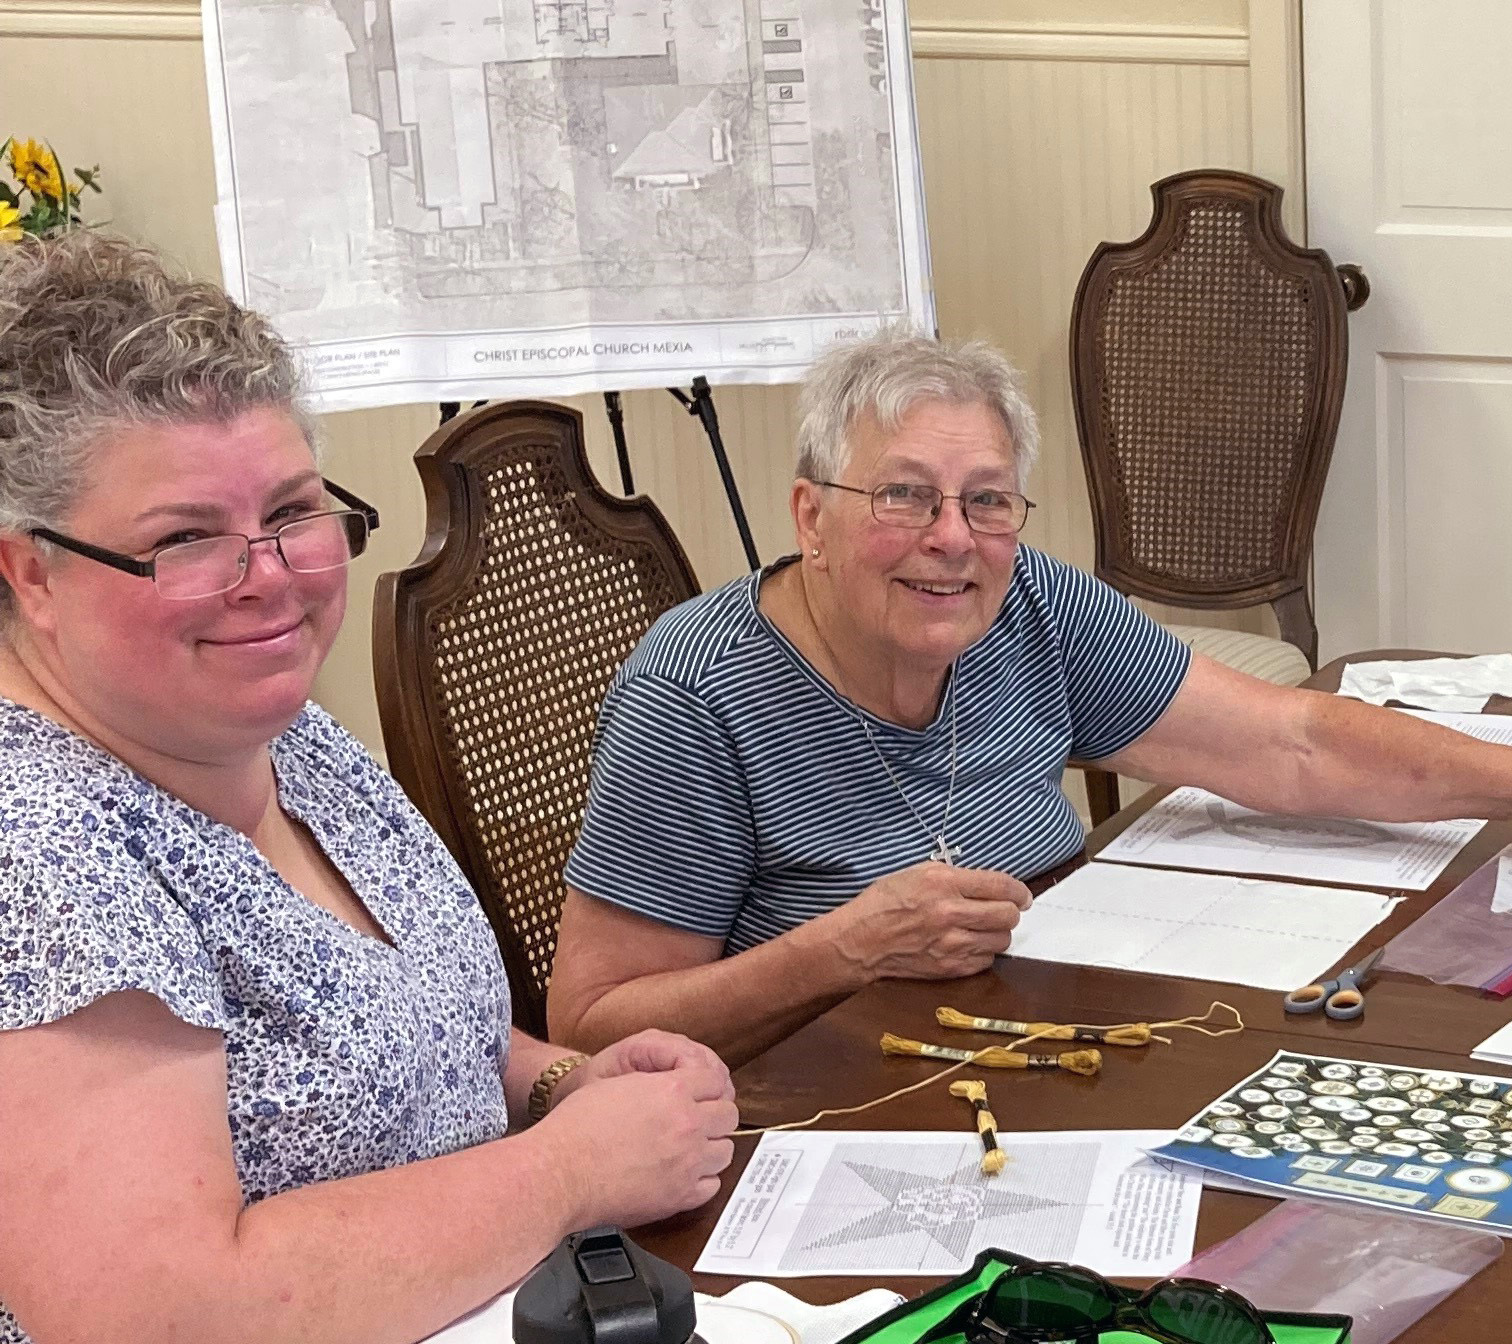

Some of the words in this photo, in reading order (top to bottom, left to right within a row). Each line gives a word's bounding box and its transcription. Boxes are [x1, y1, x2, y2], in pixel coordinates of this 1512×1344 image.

[473, 349, 519, 363] CHRIST
[522, 344, 590, 361] EPISCOPAL
[593, 342, 650, 355] CHURCH
[653, 341, 693, 353] MEXIA
